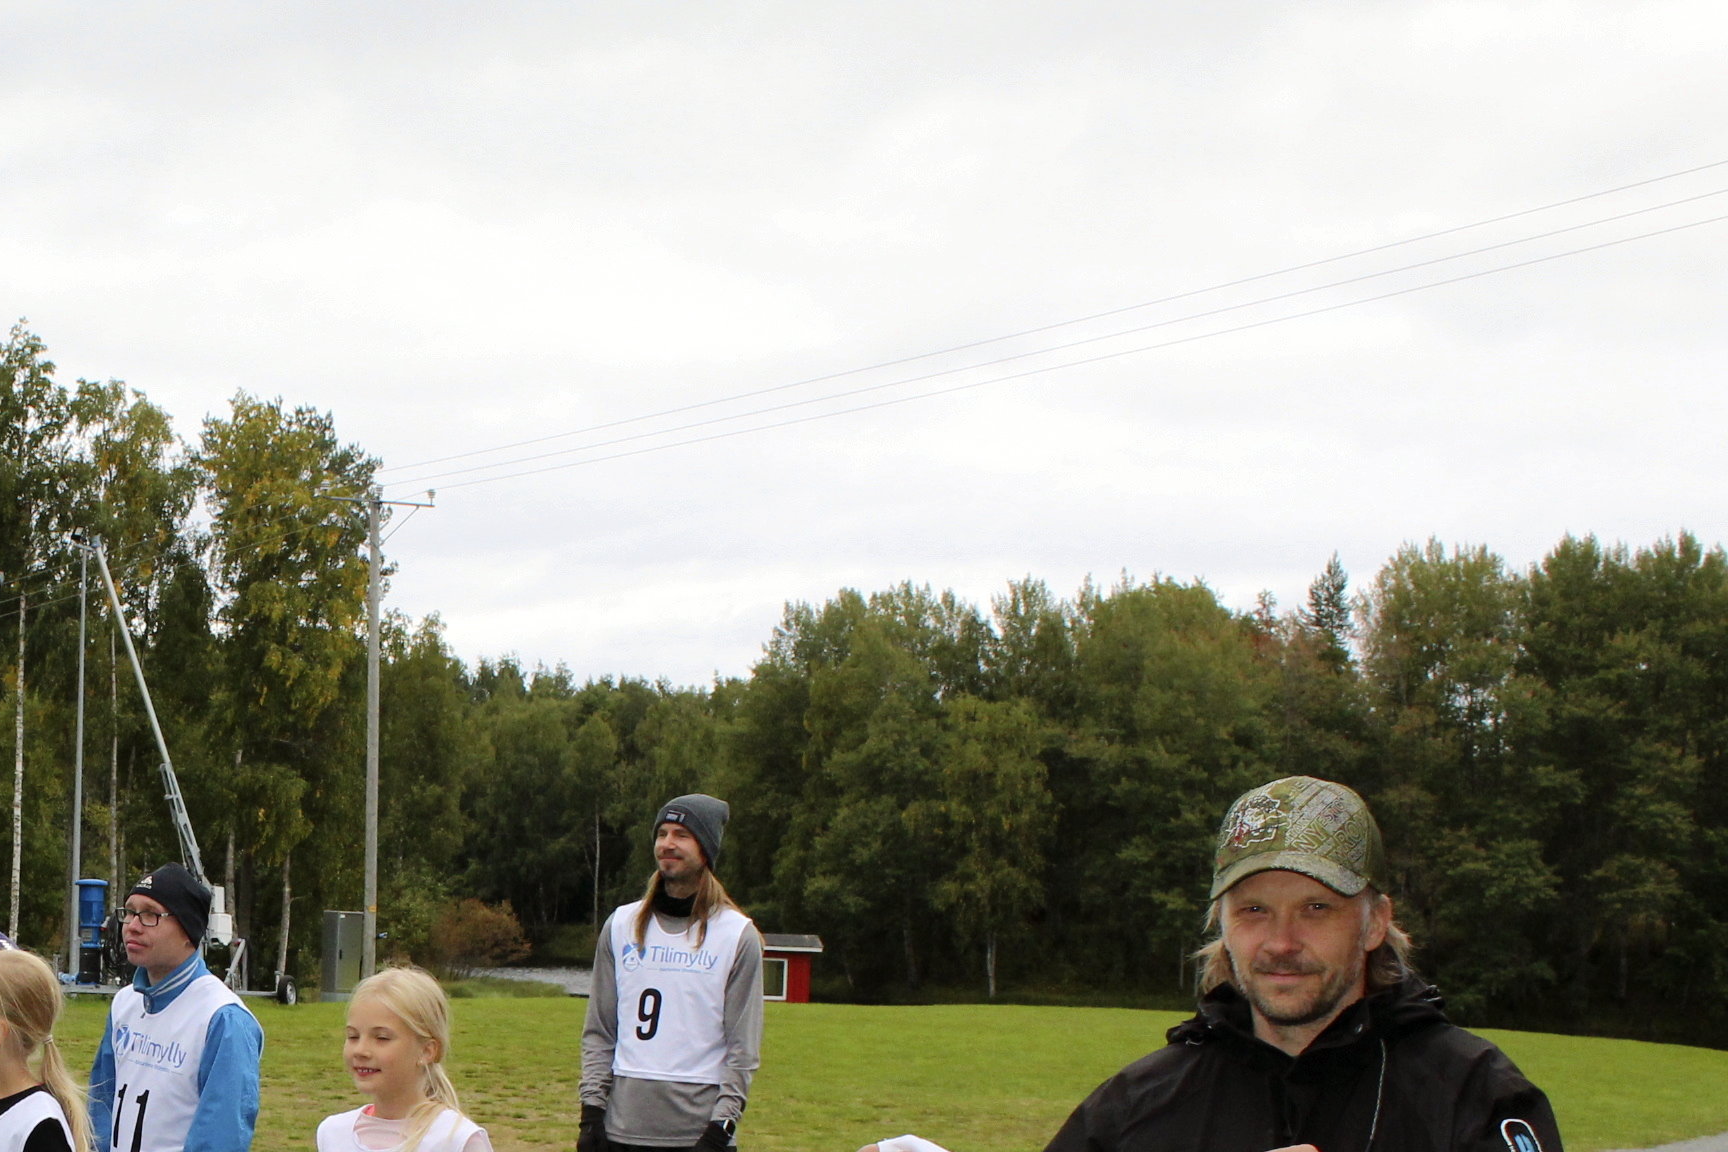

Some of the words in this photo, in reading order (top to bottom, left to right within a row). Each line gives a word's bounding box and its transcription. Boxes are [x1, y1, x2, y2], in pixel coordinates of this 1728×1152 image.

[650, 945, 718, 970] Tilimylly
[636, 987, 662, 1041] 9
[131, 1031, 187, 1068] Tilimylly
